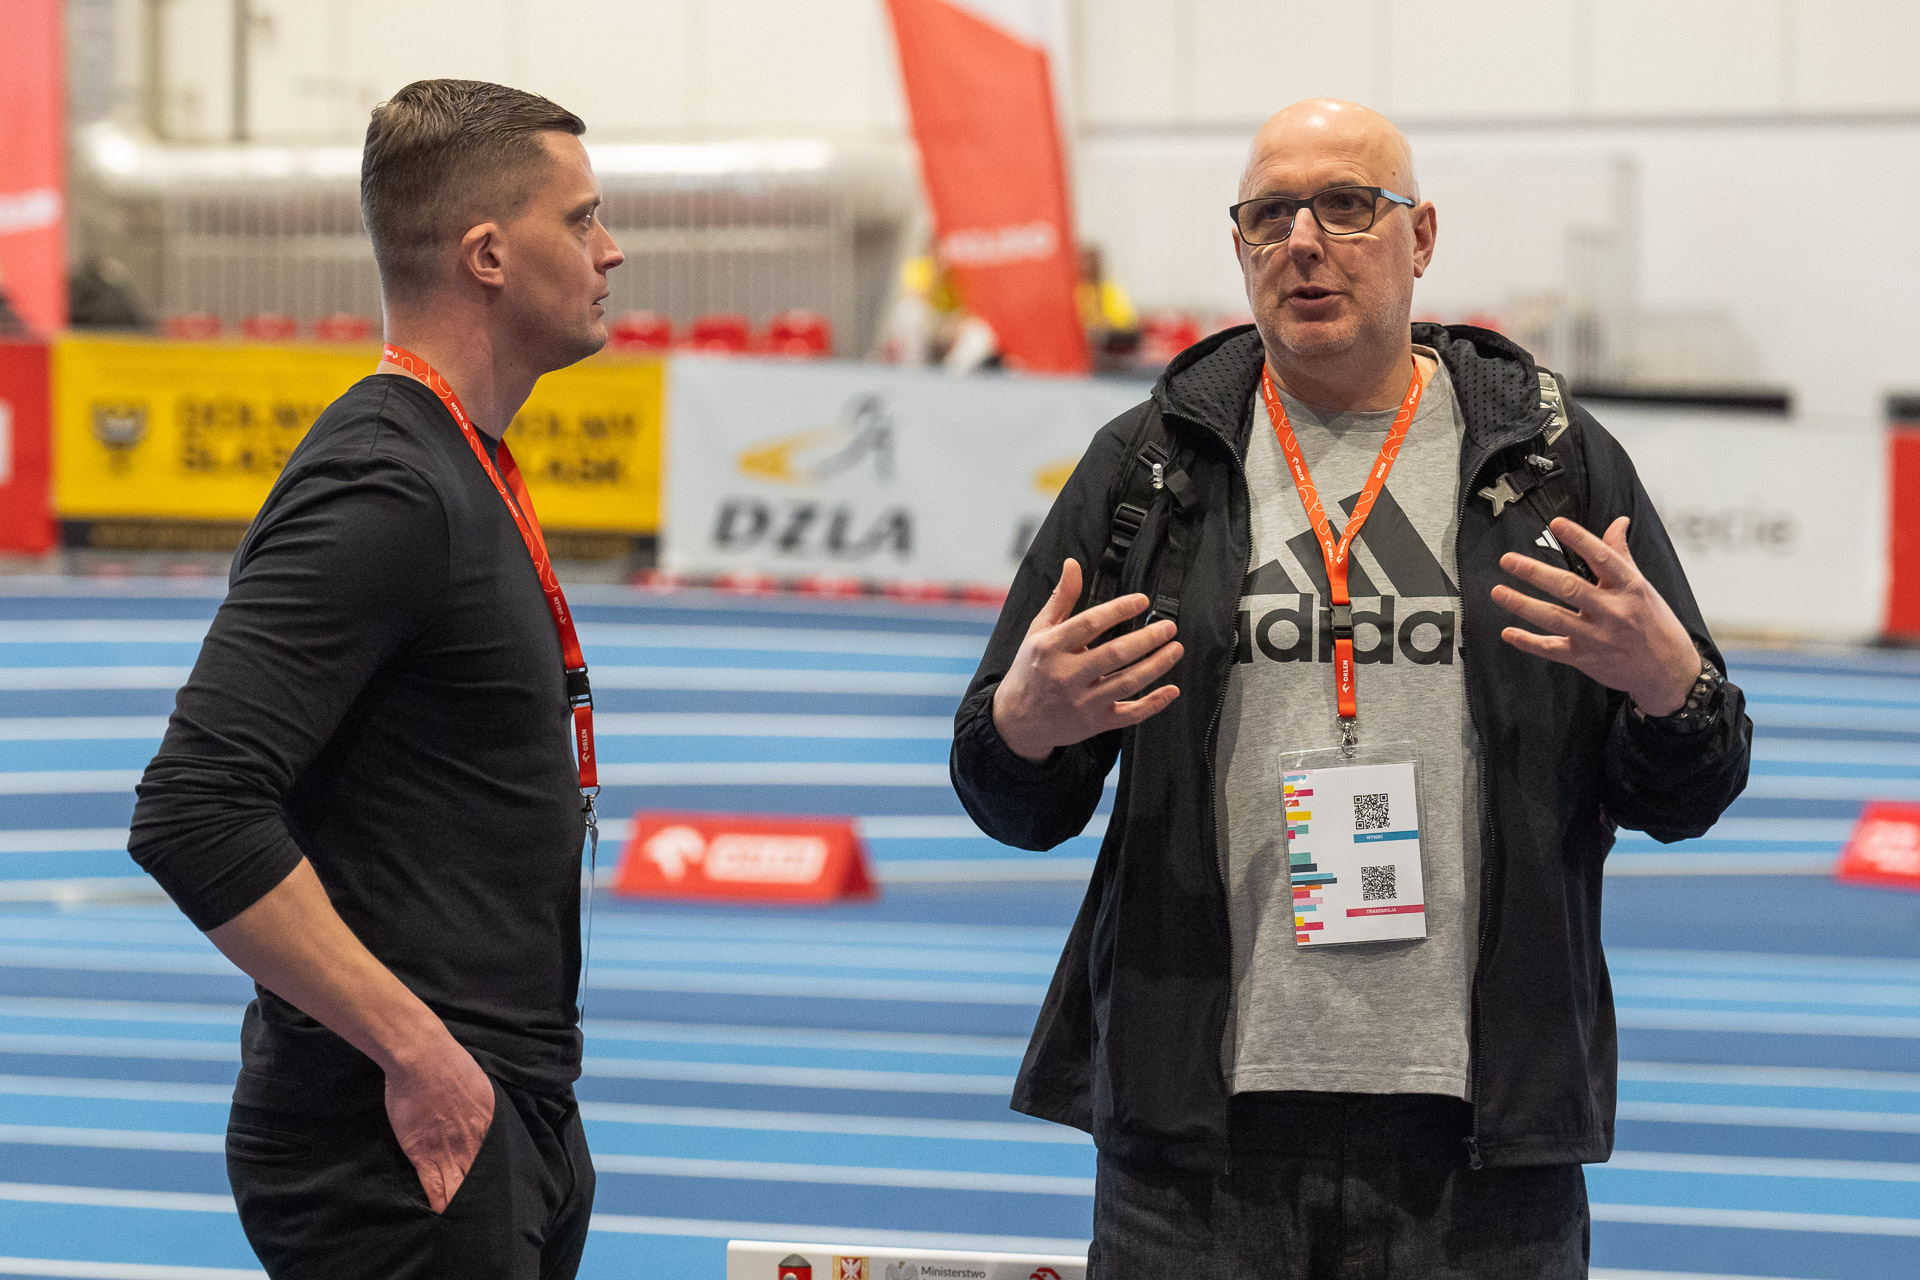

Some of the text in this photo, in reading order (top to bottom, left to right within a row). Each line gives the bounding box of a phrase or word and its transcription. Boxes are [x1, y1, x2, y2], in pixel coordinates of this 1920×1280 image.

[450, 401, 464, 421] ORLEN
[1294, 464, 1305, 481] ORLEN
[1376, 462, 1387, 479] ORLEN
[714, 500, 913, 558] DZLA
[553, 596, 564, 615] ORLEN
[1231, 592, 1466, 666] dida
[581, 729, 589, 751] ORLEN
[920, 1266, 986, 1279] Ministerstwo
